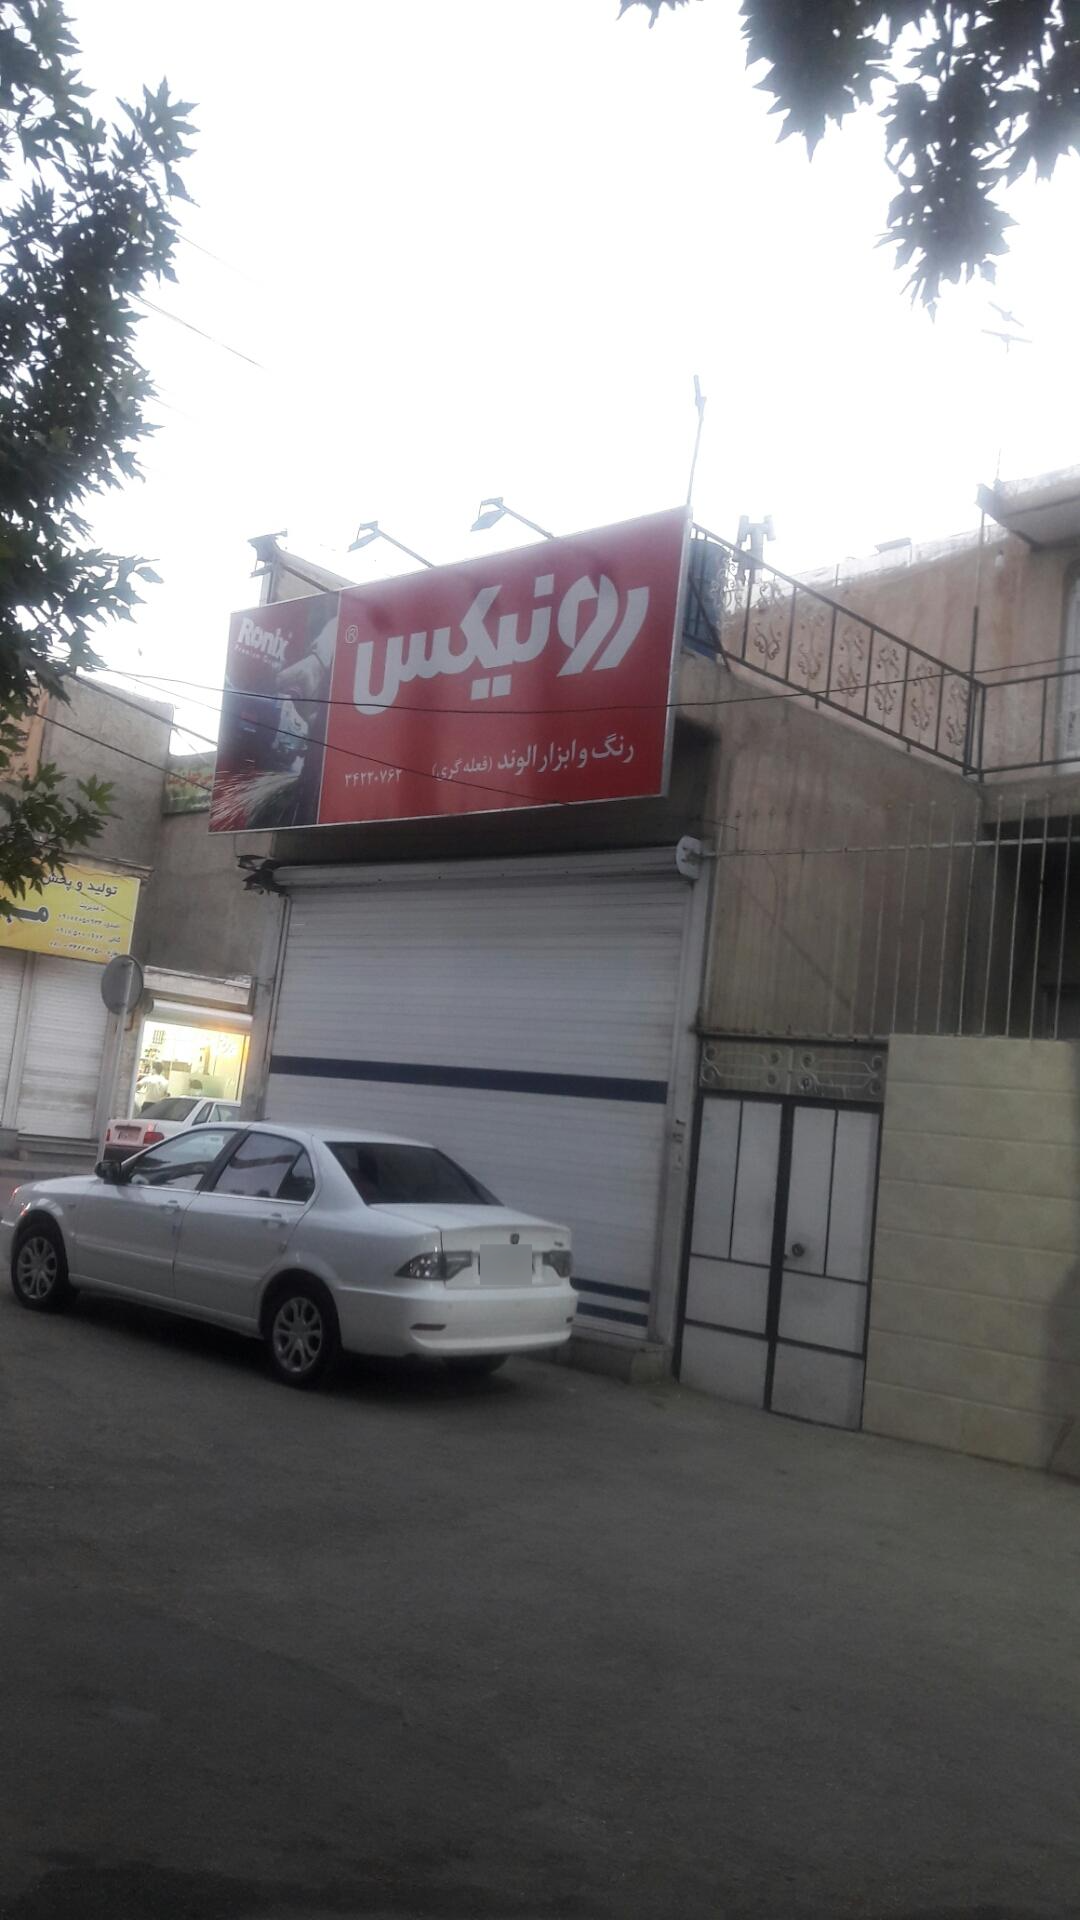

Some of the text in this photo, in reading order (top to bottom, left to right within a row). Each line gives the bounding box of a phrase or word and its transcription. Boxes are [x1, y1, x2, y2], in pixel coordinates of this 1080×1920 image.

[238, 617, 288, 660] Ronix
[353, 573, 649, 716] رونیکس
[497, 743, 537, 776] الوند
[537, 738, 577, 773] ابزار
[577, 747, 588, 769] و
[591, 733, 634, 763] رنگ
[75, 880, 83, 892] و
[87, 882, 118, 898] تولید
